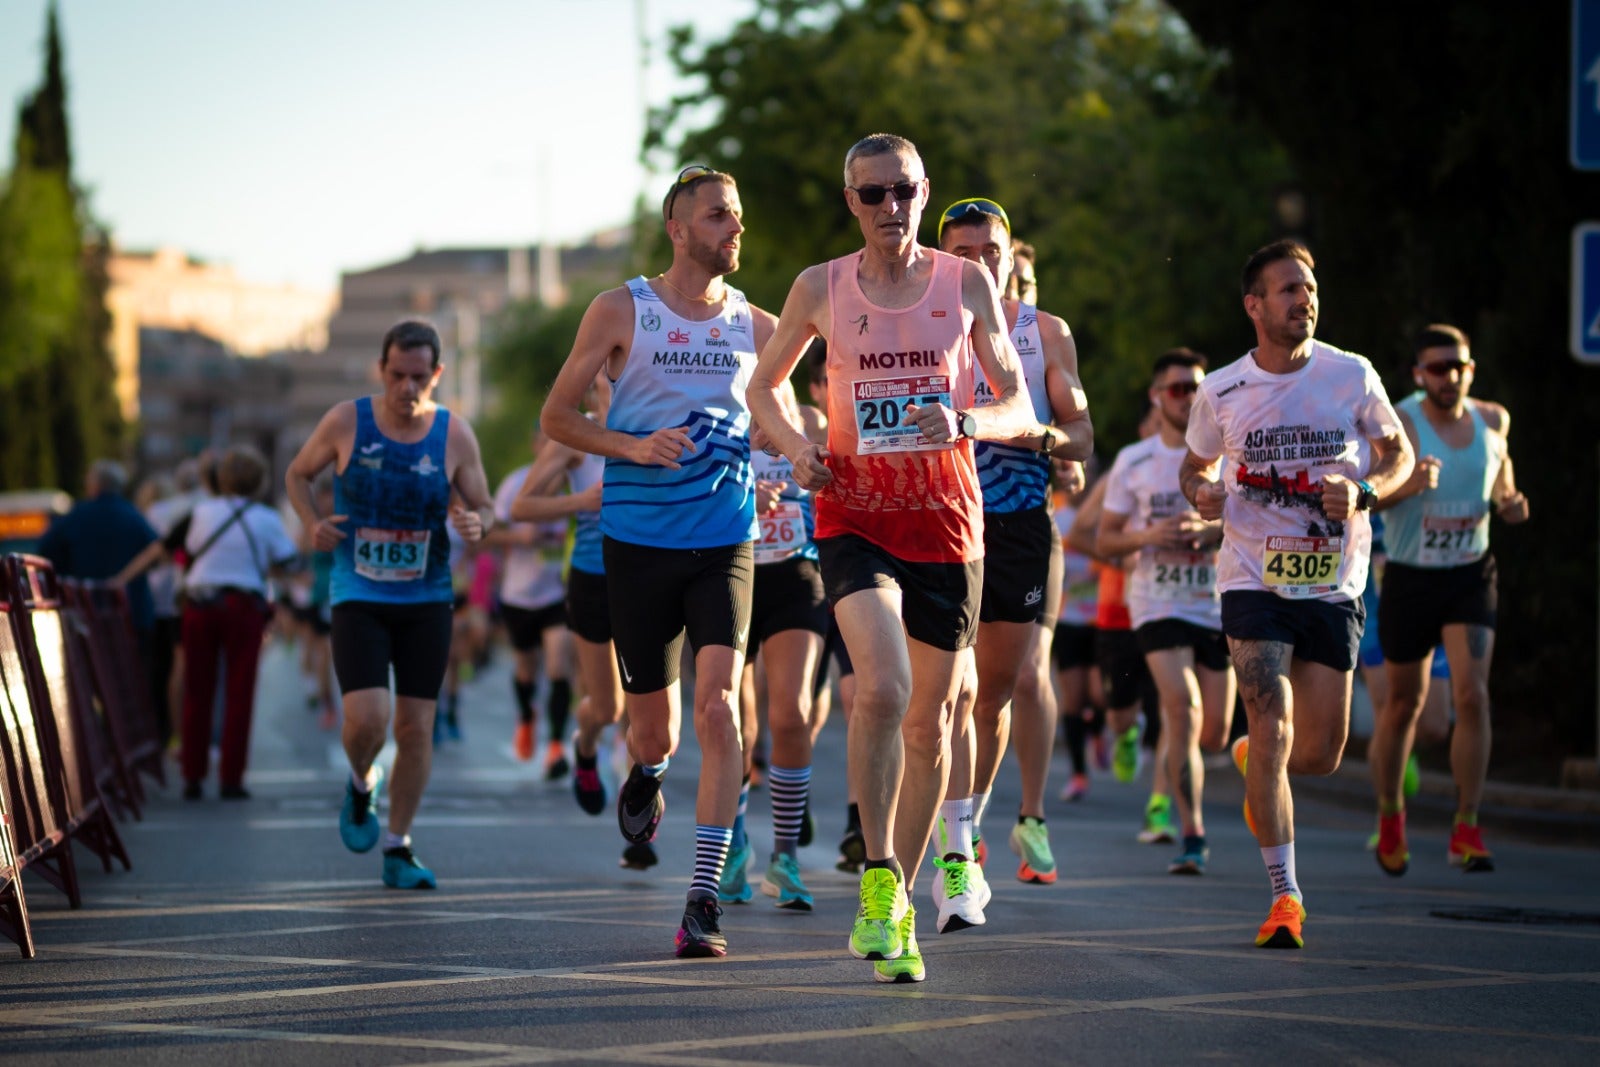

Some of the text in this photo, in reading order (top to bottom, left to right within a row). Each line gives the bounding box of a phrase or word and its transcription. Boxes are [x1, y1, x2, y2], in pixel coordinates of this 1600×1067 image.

[652, 351, 742, 368] MARACENA
[860, 350, 940, 370] MOTRIL
[857, 383, 872, 399] 40
[1244, 427, 1346, 449] 40 MEDIA MARATÓN
[1243, 447, 1281, 463] CIUDAD
[1284, 446, 1298, 460] DE
[753, 520, 795, 545] 26
[1424, 529, 1476, 549] 2277
[358, 542, 418, 564] 4163
[1269, 537, 1283, 550] 40
[1155, 565, 1210, 585] 2418
[1266, 553, 1333, 579] 4305
